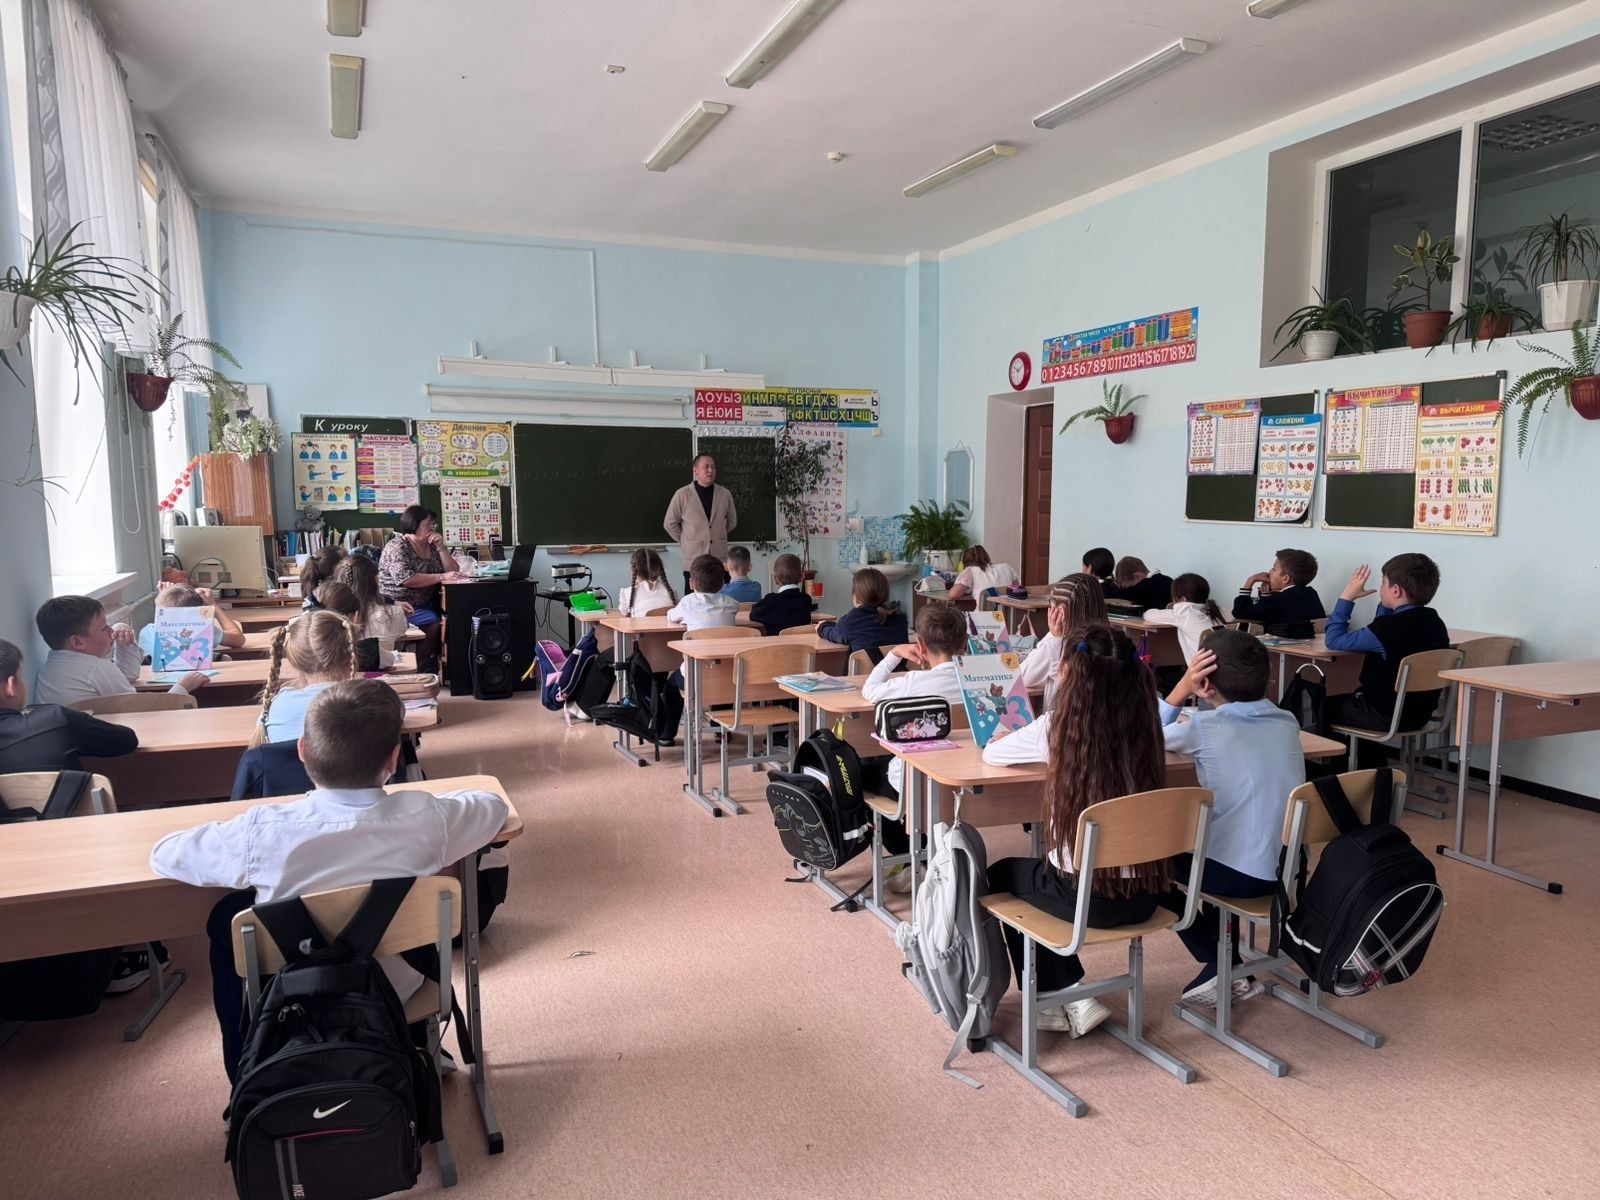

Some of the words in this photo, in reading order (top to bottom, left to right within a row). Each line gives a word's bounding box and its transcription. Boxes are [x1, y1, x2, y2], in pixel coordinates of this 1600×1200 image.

[1042, 369, 1047, 381] 0
[1049, 368, 1052, 380] 1
[1054, 367, 1059, 379] 2
[1060, 366, 1066, 378] 3
[1067, 364, 1072, 377] 4
[1074, 363, 1079, 376] 5
[1080, 362, 1086, 375] 6
[1087, 361, 1093, 374] 7
[1094, 360, 1099, 373] 8
[1101, 359, 1106, 372] 9
[1108, 358, 1114, 371] 10
[1115, 356, 1121, 370] 11
[1122, 355, 1129, 368] 12
[1130, 354, 1137, 367] 13
[1137, 352, 1144, 366] 14
[1145, 350, 1152, 365] 15
[1153, 349, 1160, 363] 16
[1161, 348, 1168, 363] 17
[1169, 346, 1177, 361] 18
[1178, 345, 1186, 360] 19
[1186, 344, 1195, 358] 20
[1347, 388, 1400, 399] ВЫЧИТАНИЕ
[872, 397, 878, 406] Ь
[1207, 401, 1241, 411] СЛОЖЕНИЕ
[1440, 404, 1486, 415] ВЫЧИТАНИЕ
[314, 418, 326, 432] К
[330, 423, 369, 433] уроку
[1275, 417, 1305, 425] СЛОЖЕНИЕ
[452, 423, 487, 431] Деление
[963, 674, 1014, 683] Математика
